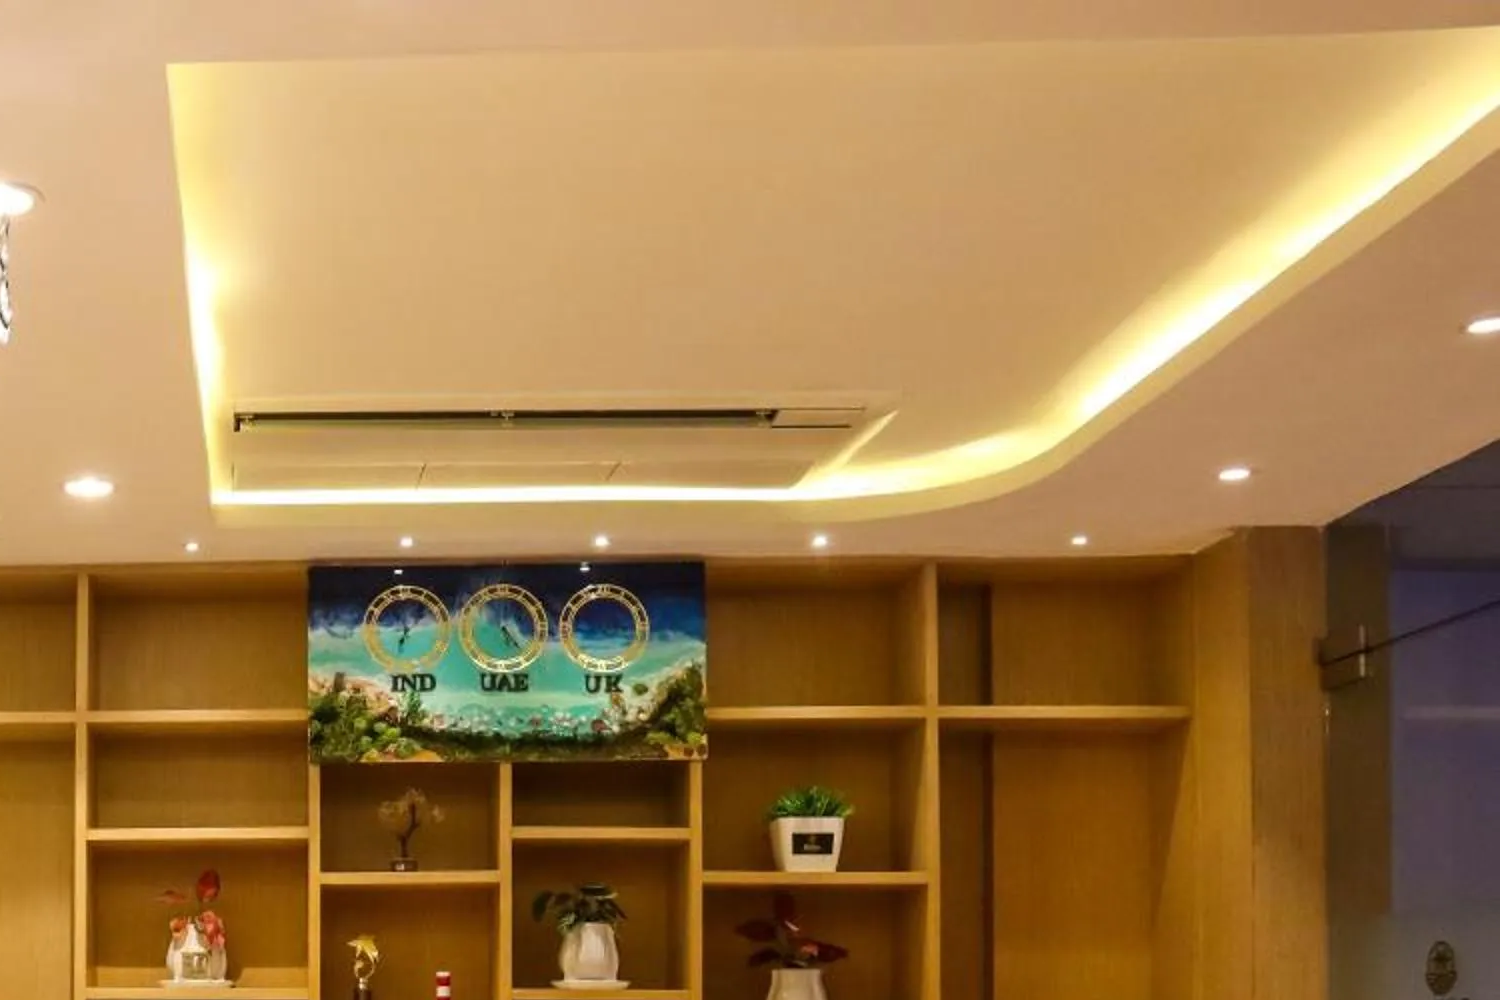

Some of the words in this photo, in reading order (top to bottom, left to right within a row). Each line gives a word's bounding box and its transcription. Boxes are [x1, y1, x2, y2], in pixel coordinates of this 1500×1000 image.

[390, 673, 437, 693] IND
[479, 673, 529, 693] UAE
[584, 673, 624, 693] UK
